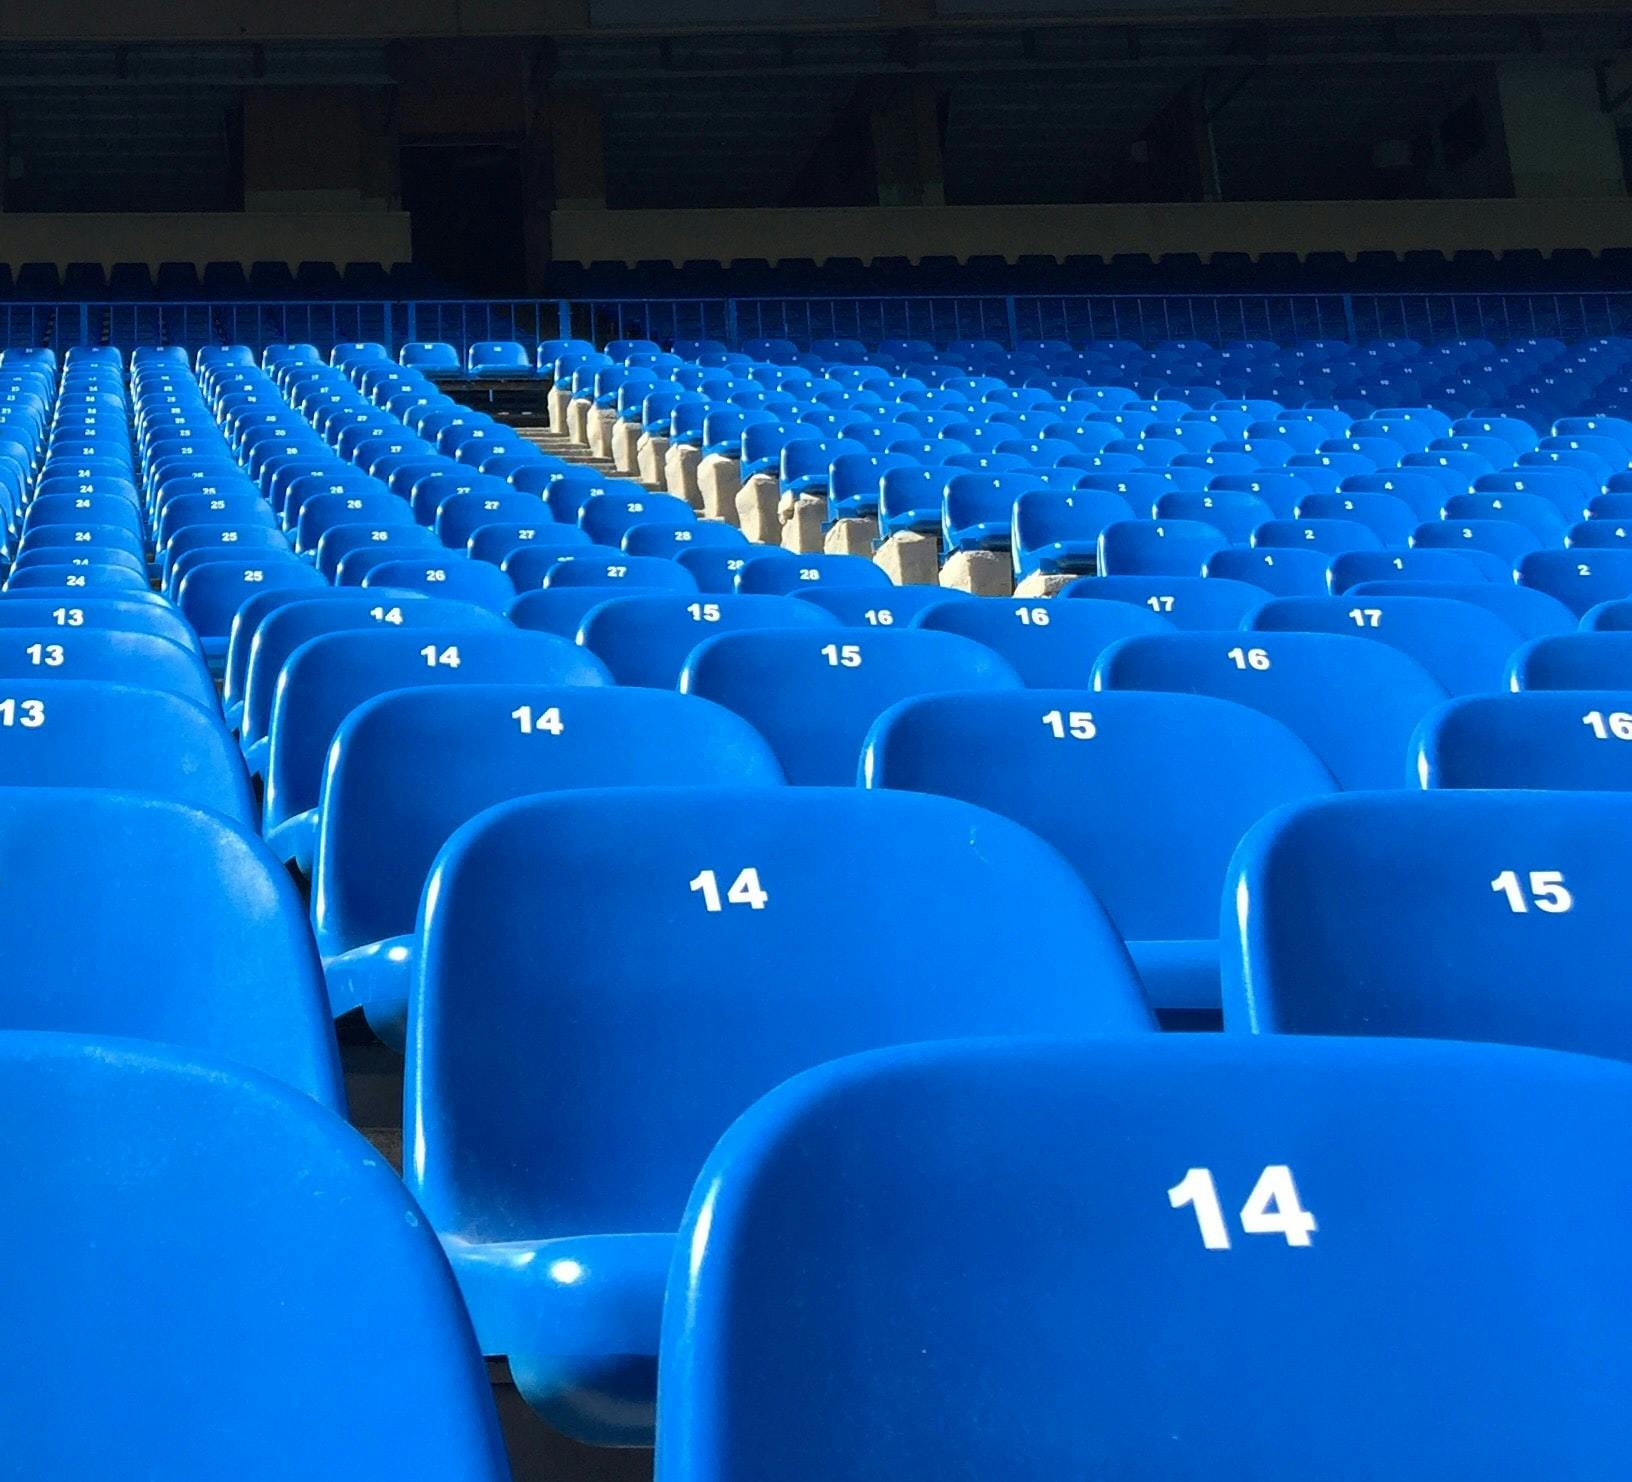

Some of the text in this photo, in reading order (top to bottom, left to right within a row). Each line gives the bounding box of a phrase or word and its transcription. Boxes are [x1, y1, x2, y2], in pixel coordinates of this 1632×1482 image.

[211, 500, 225, 509] 25
[347, 500, 362, 508] 26
[485, 501, 499, 509] 27
[1066, 498, 1072, 506] 1
[1204, 498, 1212, 507] 2
[1345, 501, 1353, 509] 3
[1493, 500, 1502, 508] 4
[628, 503, 643, 512] 28
[75, 532, 91, 541] 24
[222, 532, 237, 541] 25
[372, 531, 388, 541] 26
[519, 530, 534, 539] 27
[675, 531, 691, 540] 28
[1157, 528, 1164, 536] 1
[1305, 530, 1315, 539] 2
[1463, 529, 1472, 538] 3
[1616, 528, 1625, 537] 4
[1265, 556, 1273, 565] 1
[1393, 558, 1402, 569] 1
[607, 566, 626, 577] 27
[800, 569, 819, 580] 28
[1578, 565, 1590, 575] 2
[245, 571, 263, 581] 25
[426, 570, 445, 581] 26
[67, 576, 85, 586] 24
[1147, 597, 1174, 611] 17
[53, 608, 83, 625] 13
[371, 607, 403, 624] 14
[688, 603, 720, 621] 15
[1016, 607, 1049, 625] 16
[865, 610, 893, 625] 16
[1349, 609, 1382, 627] 17
[27, 644, 64, 666] 13
[421, 645, 460, 667] 14
[822, 644, 861, 667] 15
[1228, 648, 1270, 670] 16
[512, 706, 564, 735] 14
[1043, 711, 1096, 739] 15
[1582, 711, 1632, 740] 16
[690, 868, 768, 911] 14
[1492, 871, 1573, 912] 15
[1168, 1165, 1316, 1249] 14
